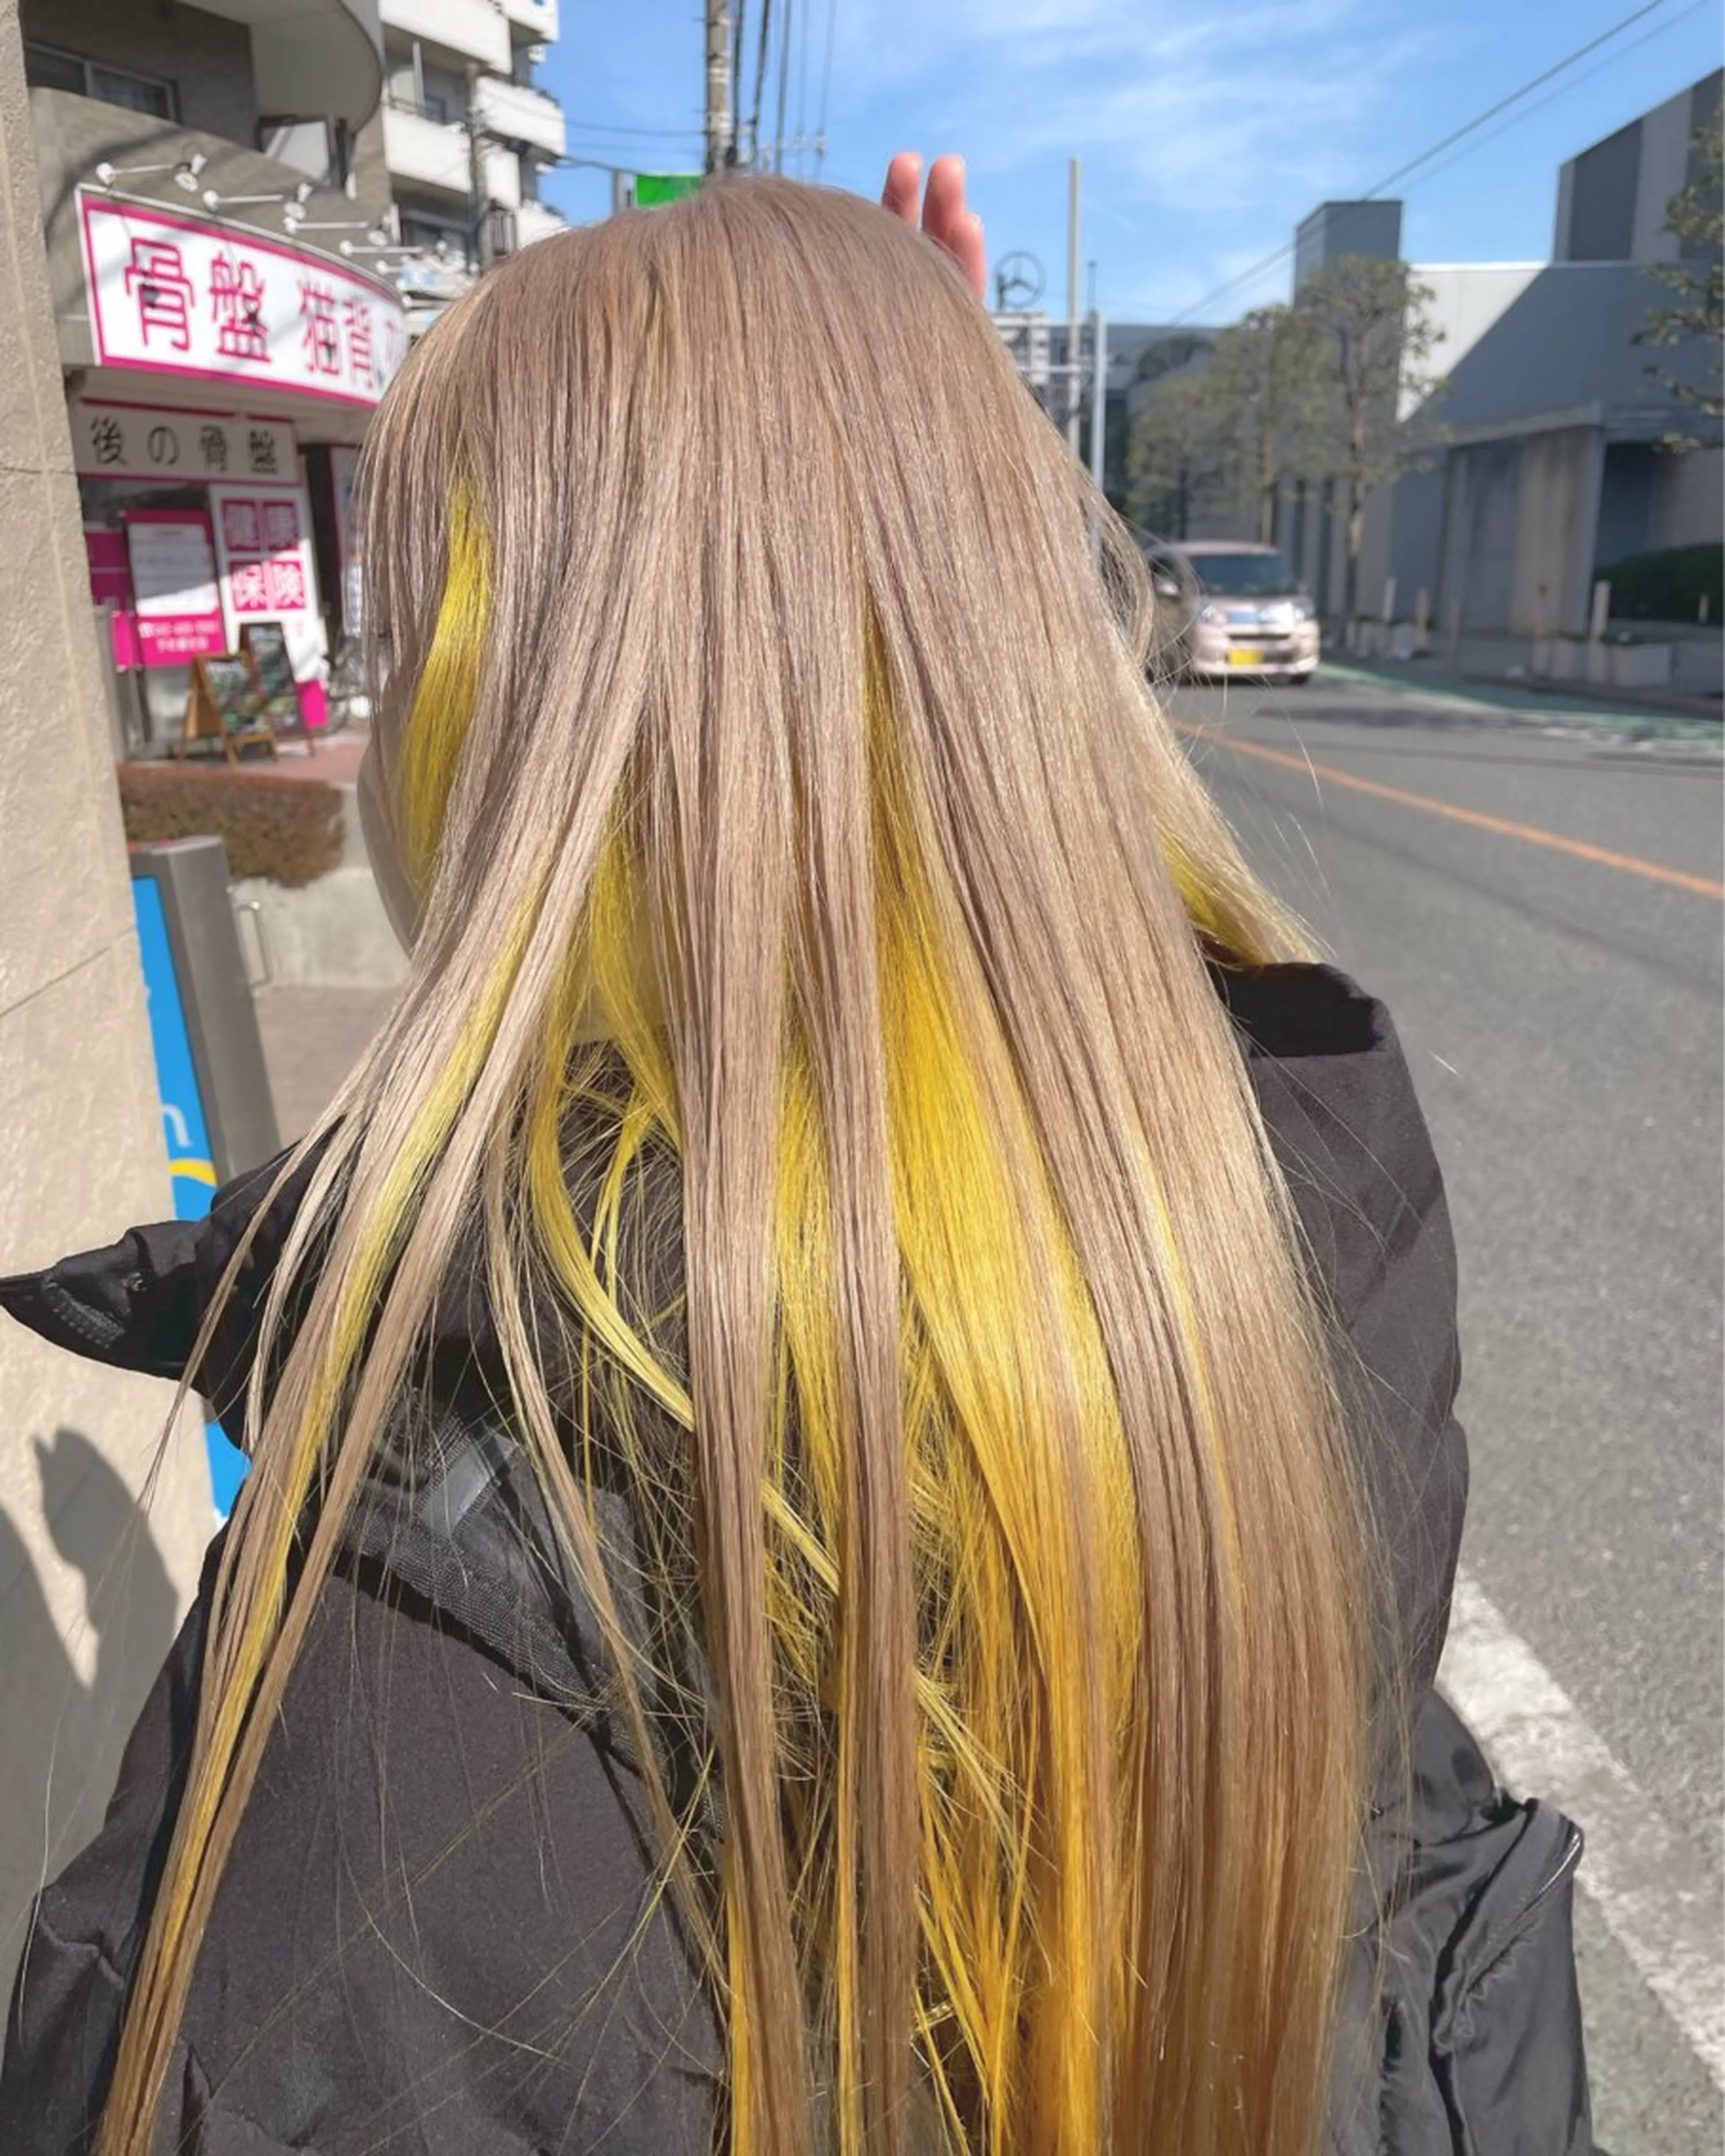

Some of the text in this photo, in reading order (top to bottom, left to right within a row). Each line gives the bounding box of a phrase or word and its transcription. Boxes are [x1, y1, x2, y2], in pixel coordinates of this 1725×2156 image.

[125, 237, 273, 363] 骨盤
[91, 416, 279, 474] 後の骨盤
